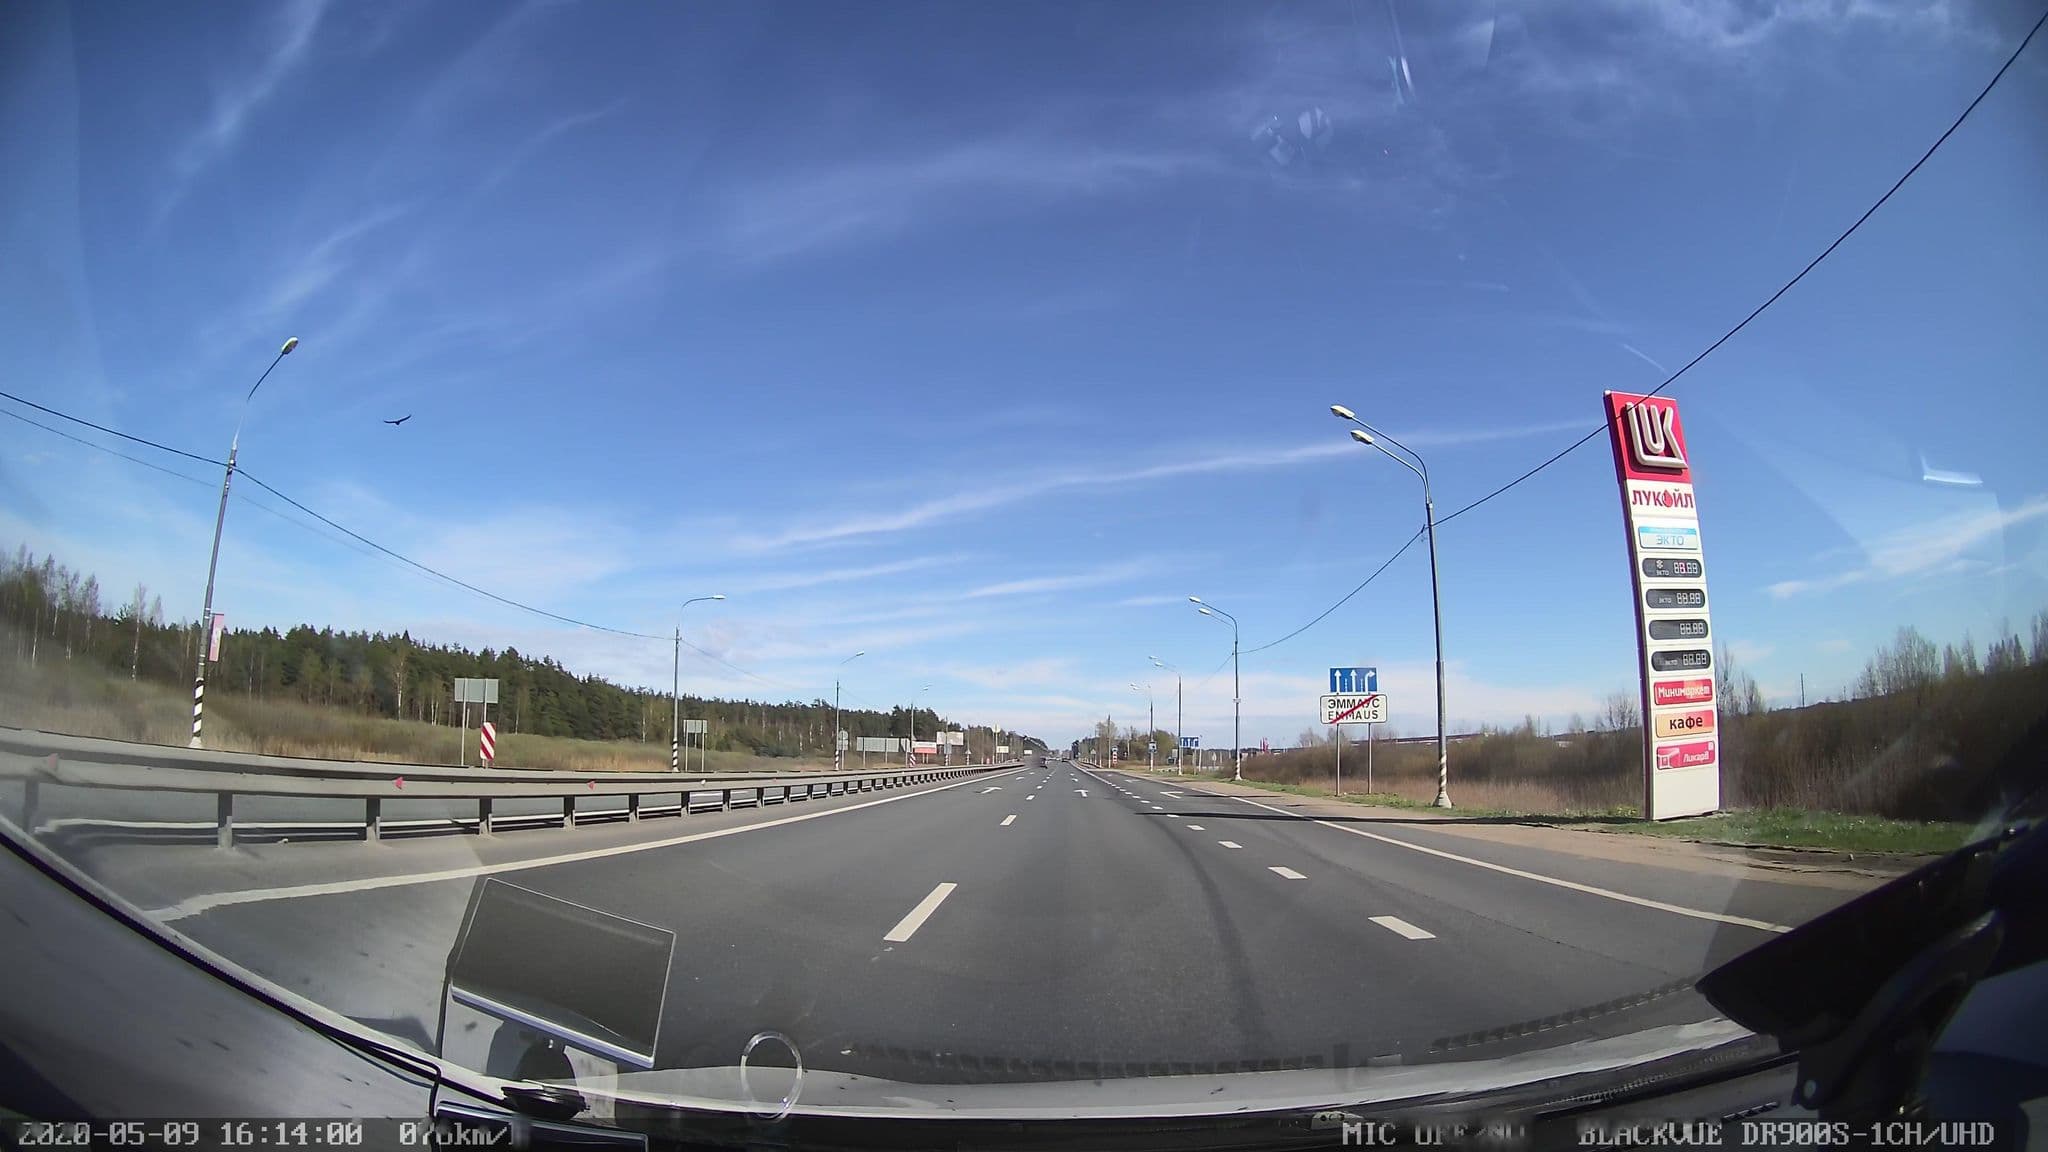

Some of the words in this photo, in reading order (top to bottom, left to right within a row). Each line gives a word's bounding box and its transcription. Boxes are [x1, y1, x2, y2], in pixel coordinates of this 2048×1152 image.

[1656, 534, 1685, 546] ЭКТО
[1328, 698, 1380, 709] ЭММАУС
[1328, 710, 1379, 721] EMMAUS
[1670, 716, 1703, 730] кафе
